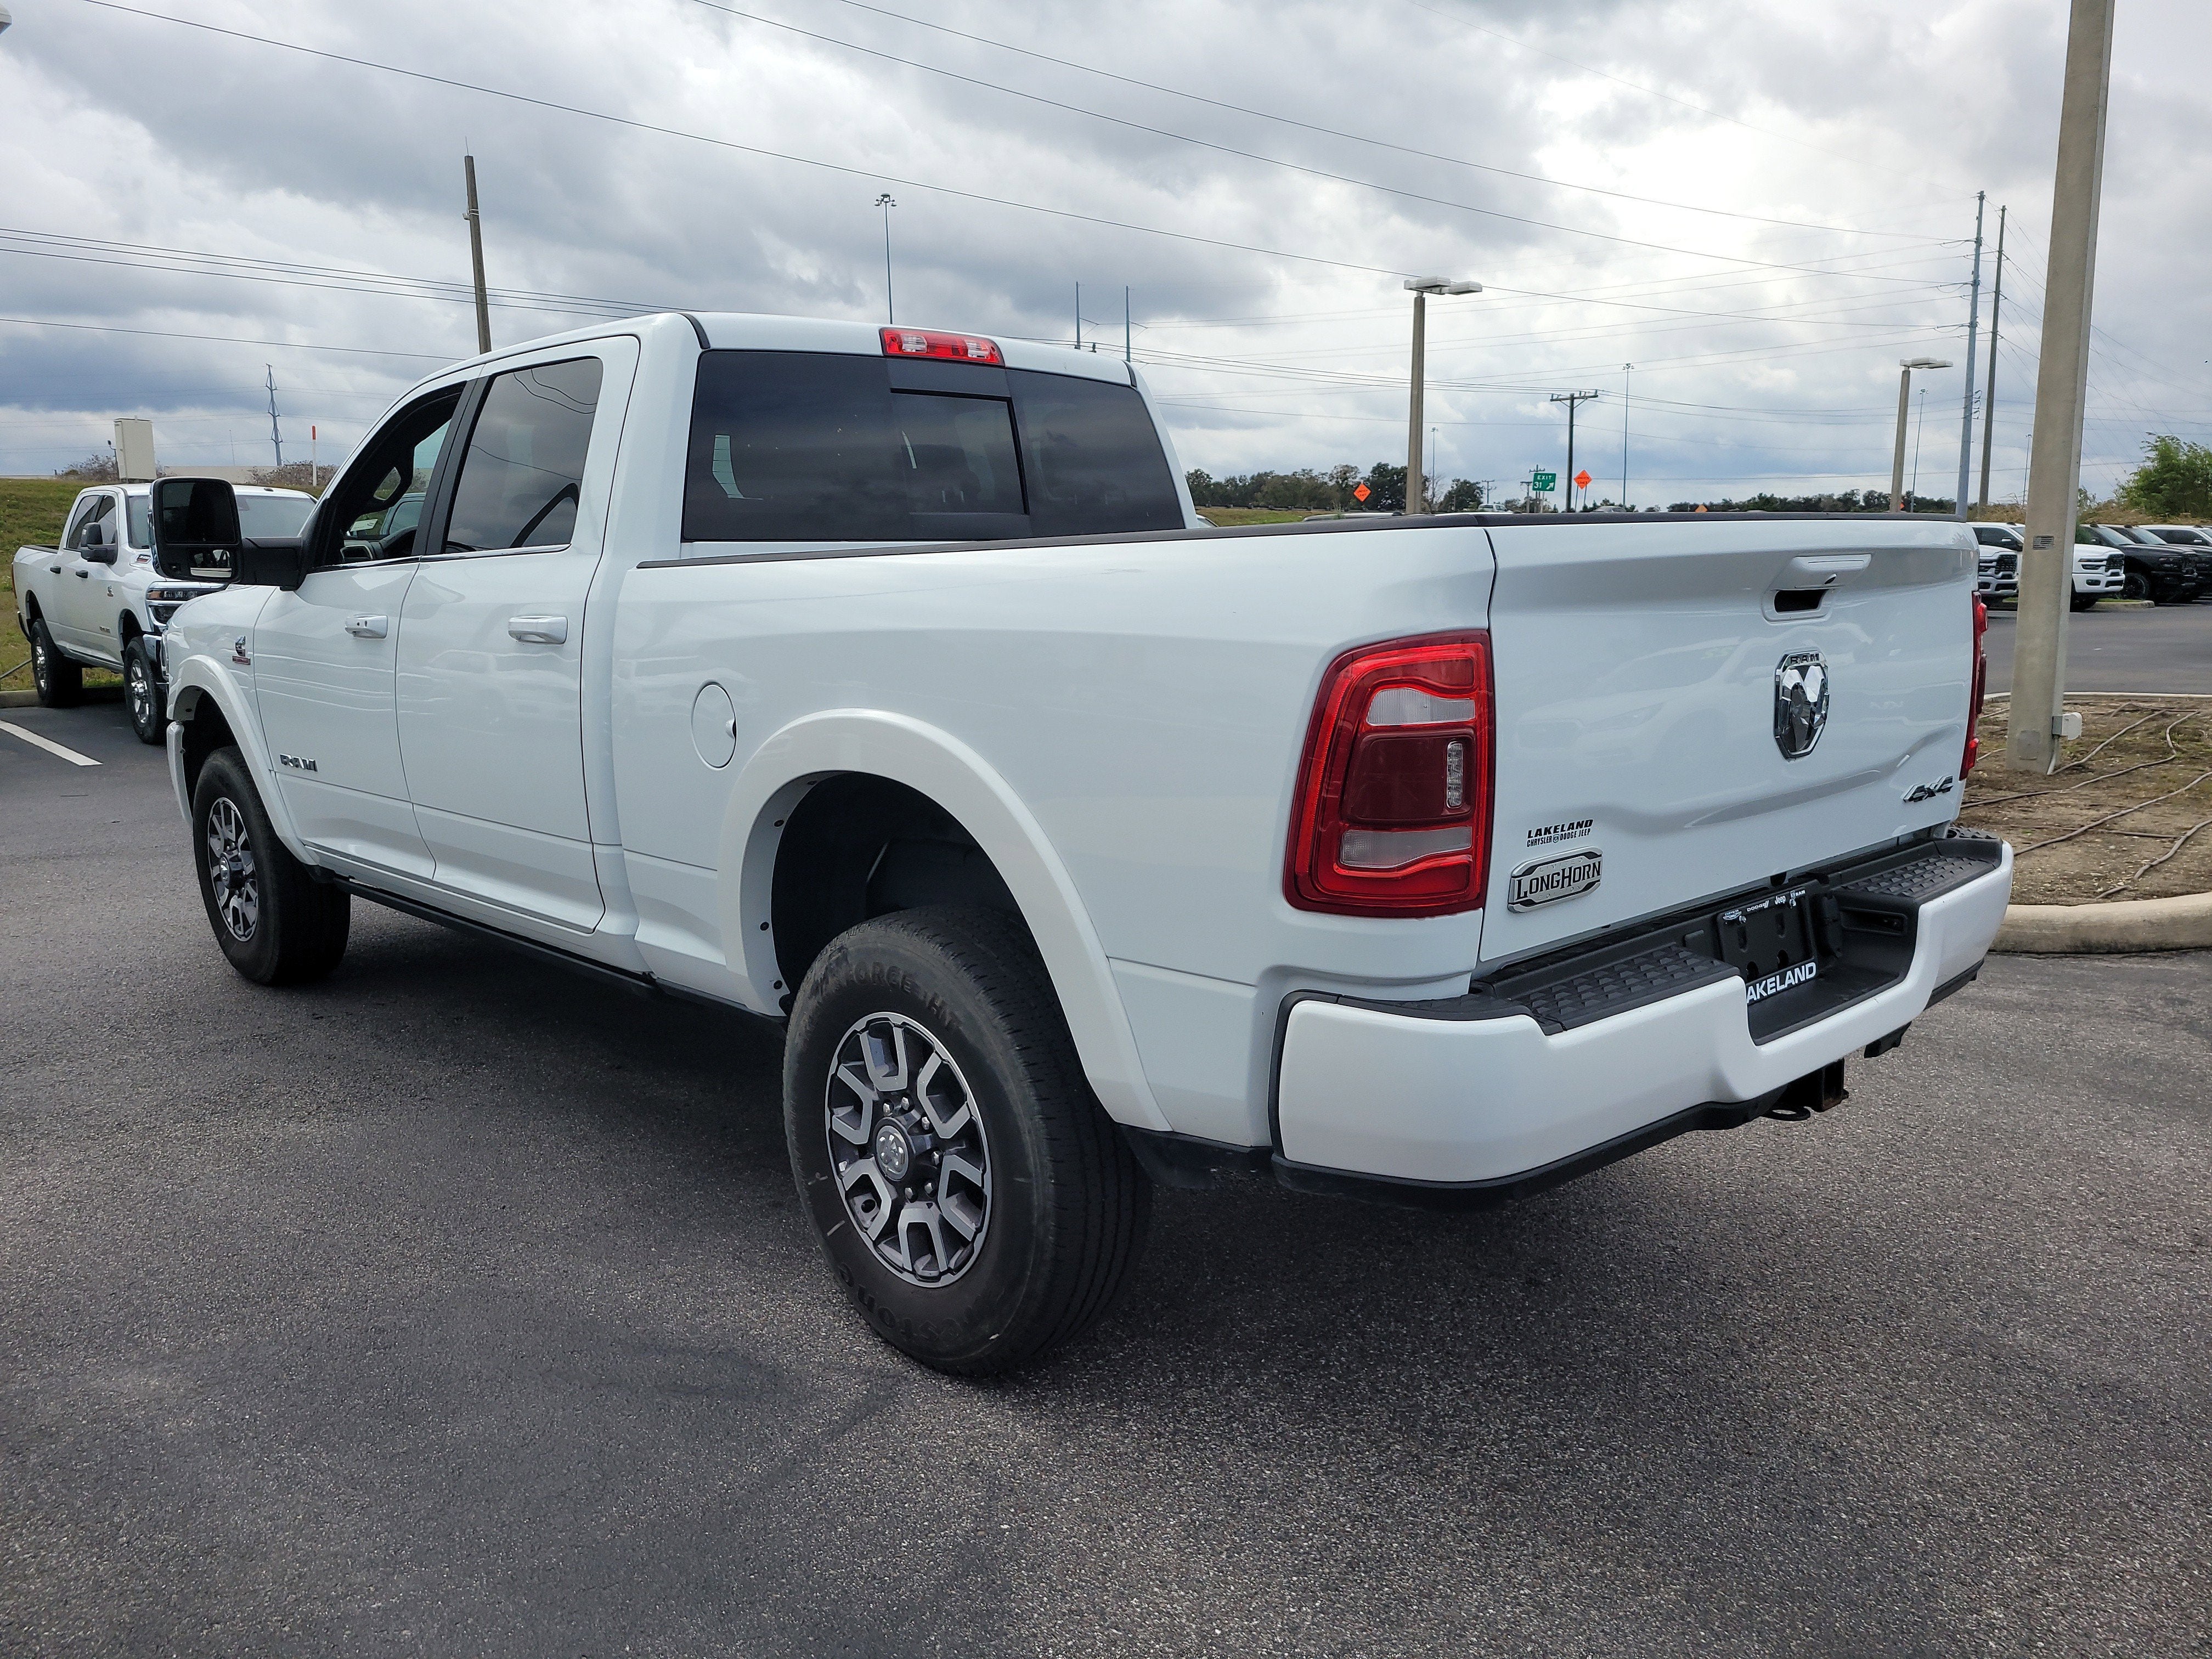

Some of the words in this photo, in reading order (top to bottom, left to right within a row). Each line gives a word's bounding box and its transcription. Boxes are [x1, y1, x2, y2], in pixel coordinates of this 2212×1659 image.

[1790, 653, 1820, 664] RAM
[279, 754, 318, 772] RAM
[1527, 819, 1593, 839] LAKELAND
[1527, 836, 1552, 847] CHRYSLER
[1560, 831, 1577, 840] DODGE
[1578, 828, 1591, 837] JEEP
[1775, 895, 1786, 905] Jeep
[1747, 962, 1816, 1003] AKELAND
